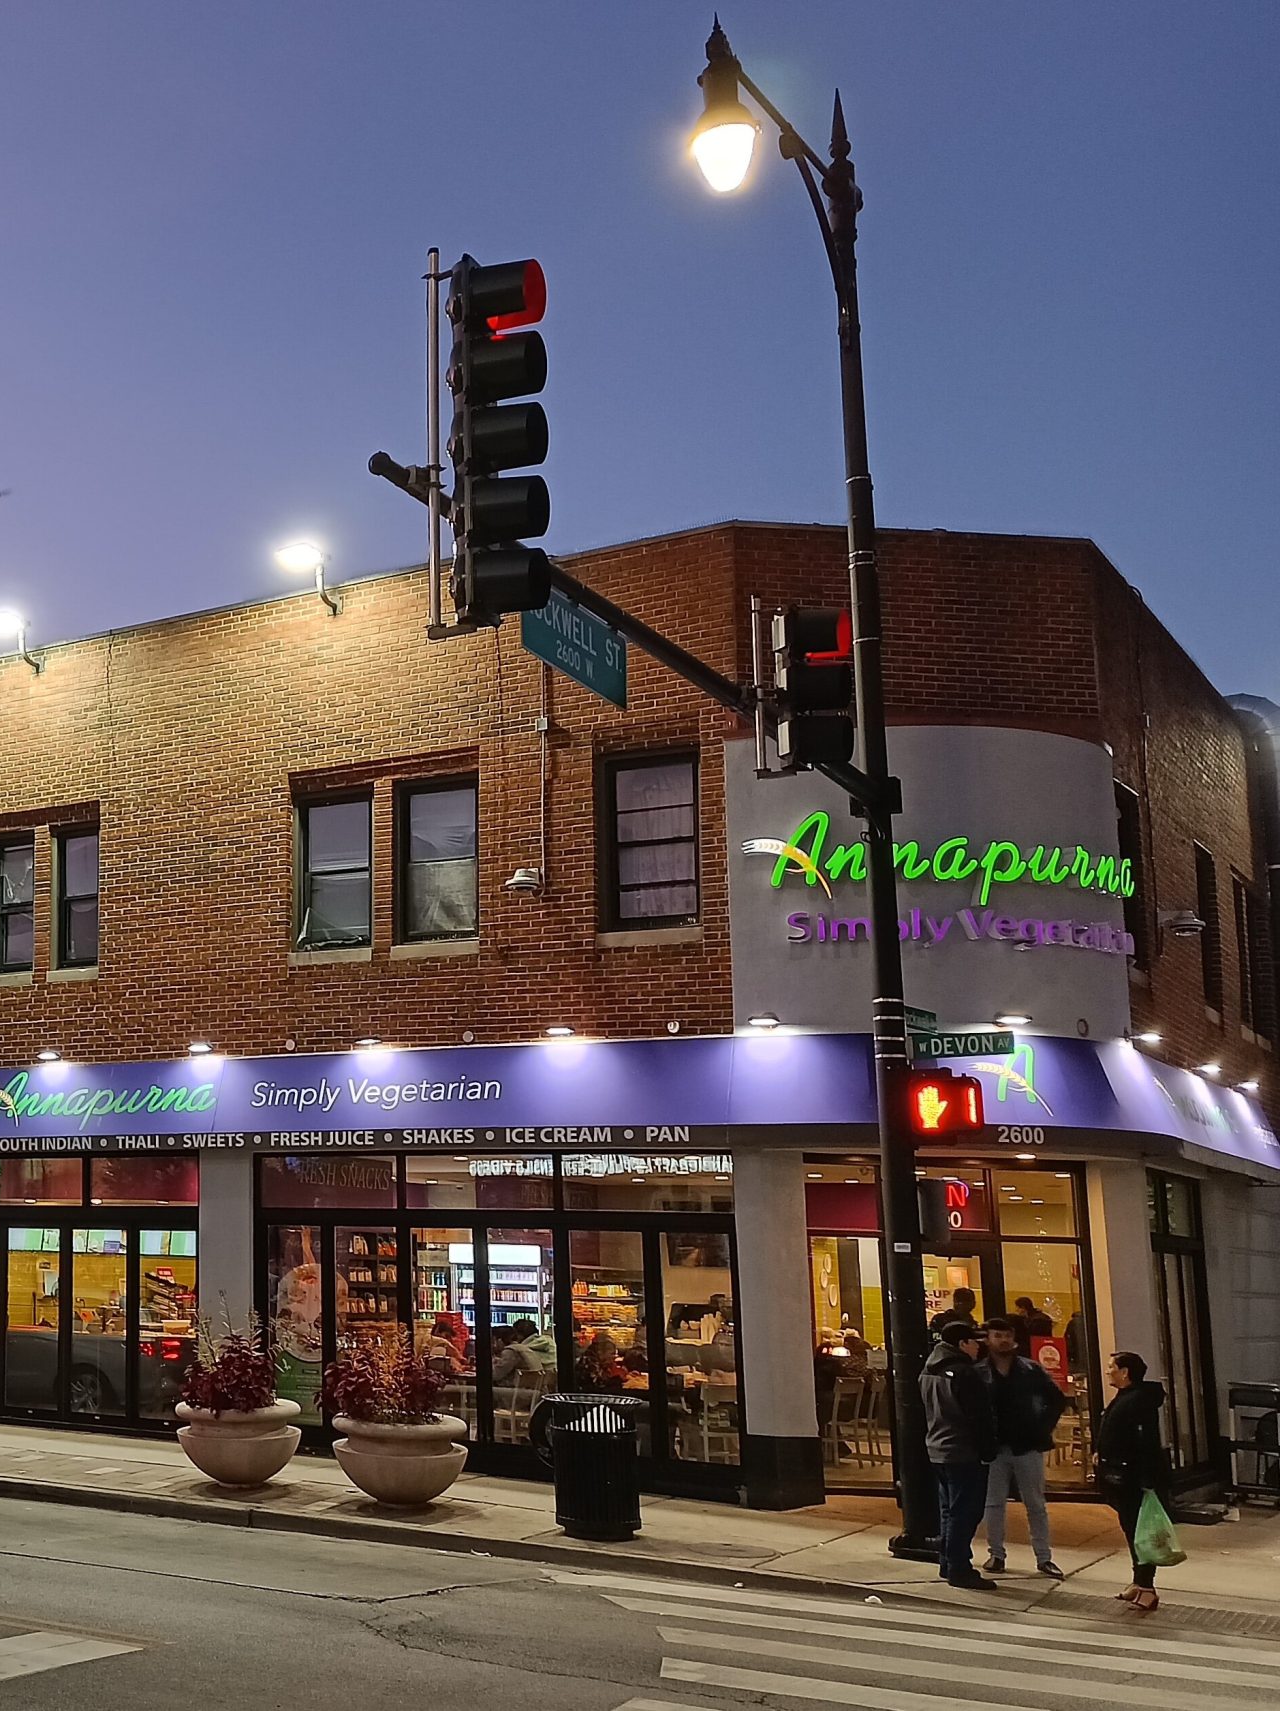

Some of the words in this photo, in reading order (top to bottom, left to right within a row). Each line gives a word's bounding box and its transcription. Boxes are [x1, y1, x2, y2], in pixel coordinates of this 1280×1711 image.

[530, 600, 597, 656] CKWELL
[556, 640, 581, 671] 2600
[770, 811, 1135, 906] Annapurna
[919, 1041, 928, 1053] W
[930, 1035, 994, 1056] DEVON
[997, 1037, 1010, 1049] AV
[251, 1079, 341, 1112] Simply
[348, 1075, 502, 1110] Vegetarian
[42, 1137, 92, 1150] INDIAN
[116, 1135, 160, 1149] THALI
[183, 1133, 245, 1148] SWEETS
[270, 1132, 322, 1147] FRESH
[326, 1130, 374, 1146] JUICE
[402, 1128, 475, 1144] SHAKES
[505, 1128, 536, 1144] ICE
[540, 1126, 612, 1143] CREAM
[645, 1126, 690, 1142] PAN
[998, 1126, 1045, 1144] 2600
[339, 1164, 391, 1190] SNACKS
